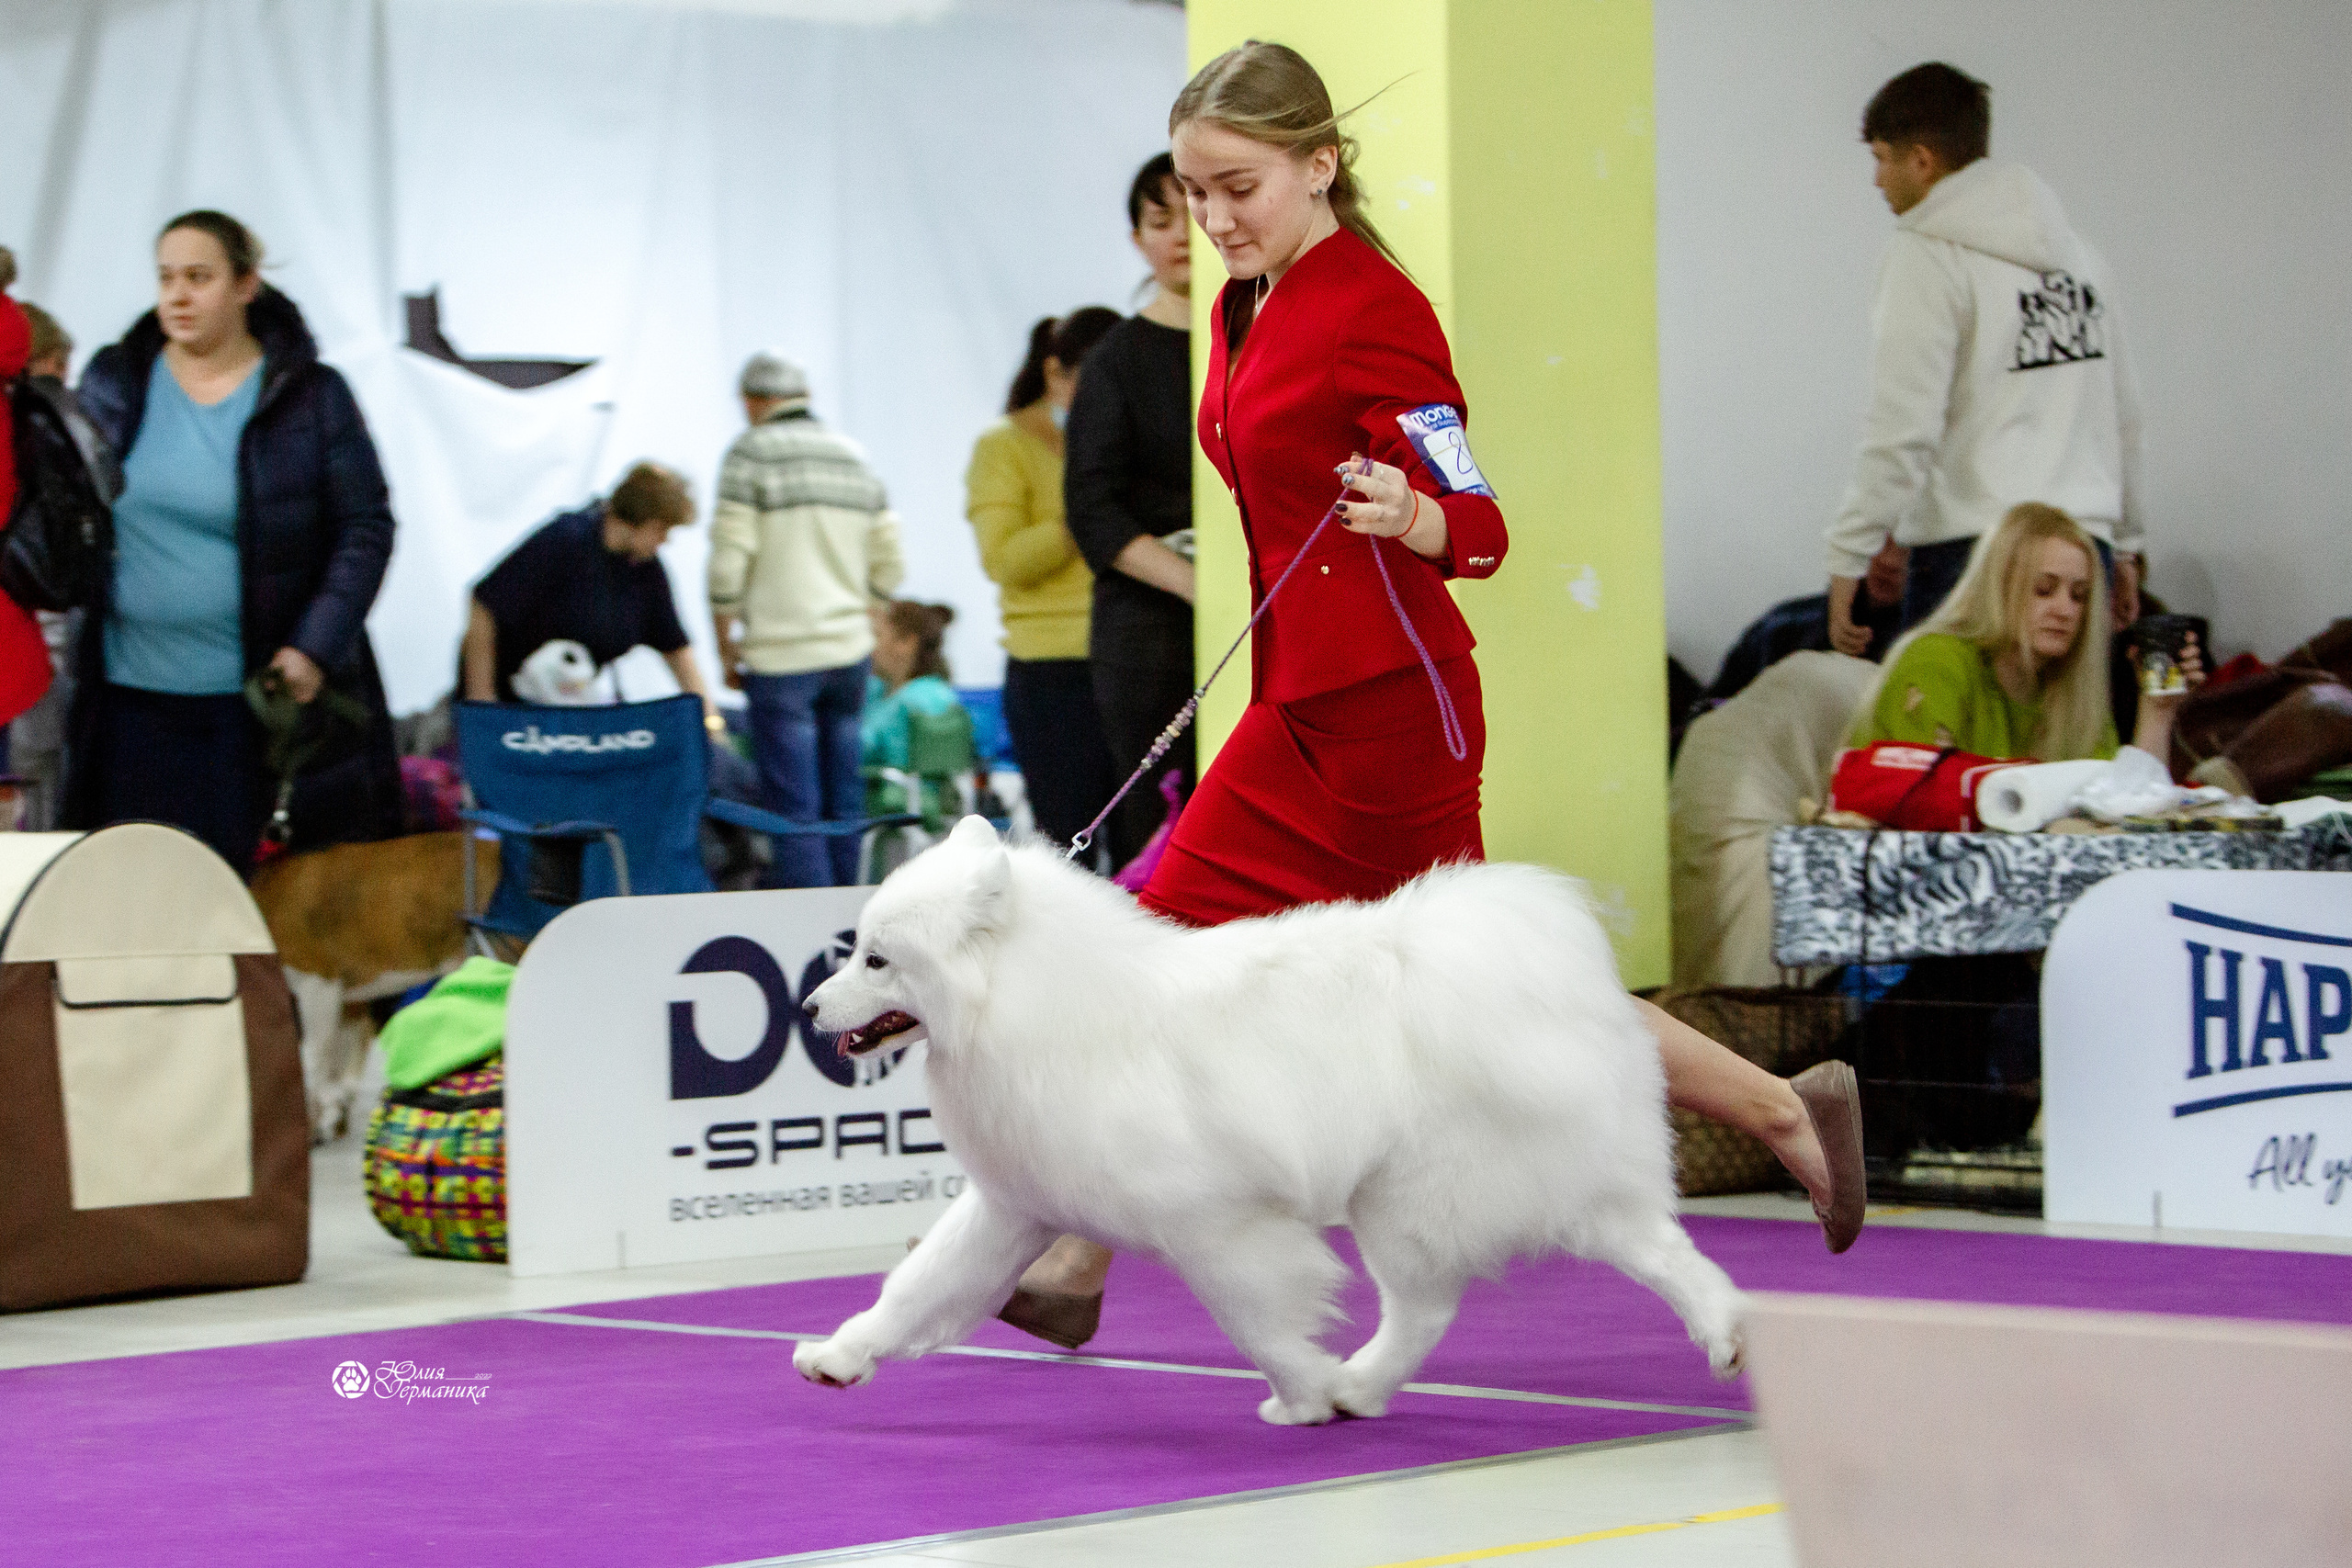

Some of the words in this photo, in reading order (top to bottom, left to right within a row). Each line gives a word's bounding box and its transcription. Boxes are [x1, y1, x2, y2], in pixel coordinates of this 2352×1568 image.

[667, 929, 911, 1100] DO
[669, 1109, 947, 1170] -SPAC
[2247, 1133, 2317, 1192] All
[668, 1186, 831, 1223] вселенная
[839, 1170, 935, 1209] вашей
